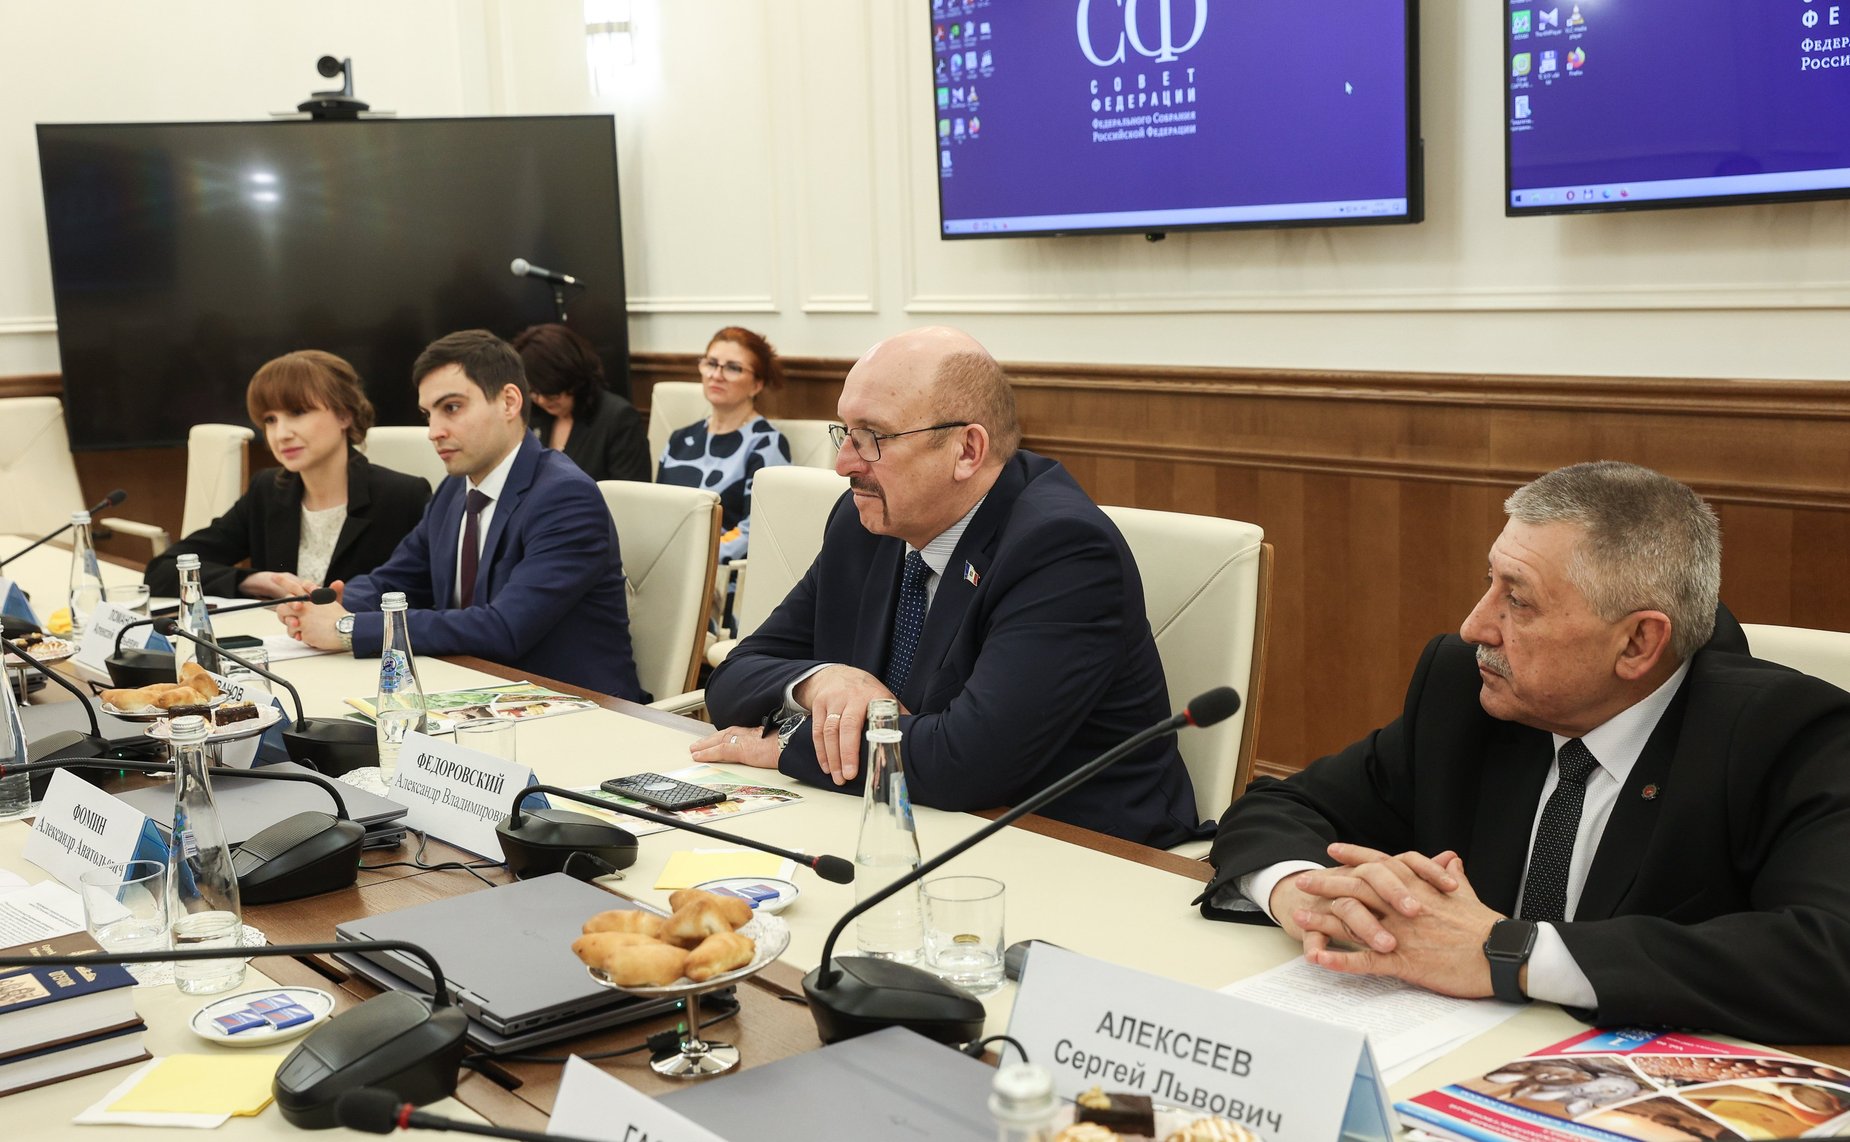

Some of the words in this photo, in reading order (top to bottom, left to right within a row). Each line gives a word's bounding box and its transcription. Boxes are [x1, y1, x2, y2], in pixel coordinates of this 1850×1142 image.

[1091, 87, 1196, 112] ФЕДЕРАЦИИ
[417, 752, 505, 795] ФЕДОРОВСКИЙ
[395, 772, 441, 805] Александр
[441, 787, 508, 822] Владимирови
[36, 816, 76, 855] Александр
[73, 803, 108, 836] ФОМИН
[1096, 1011, 1253, 1078] АЛЕКСЕЕВ
[1054, 1038, 1147, 1090] Сергей
[1151, 1069, 1283, 1134] Львович
